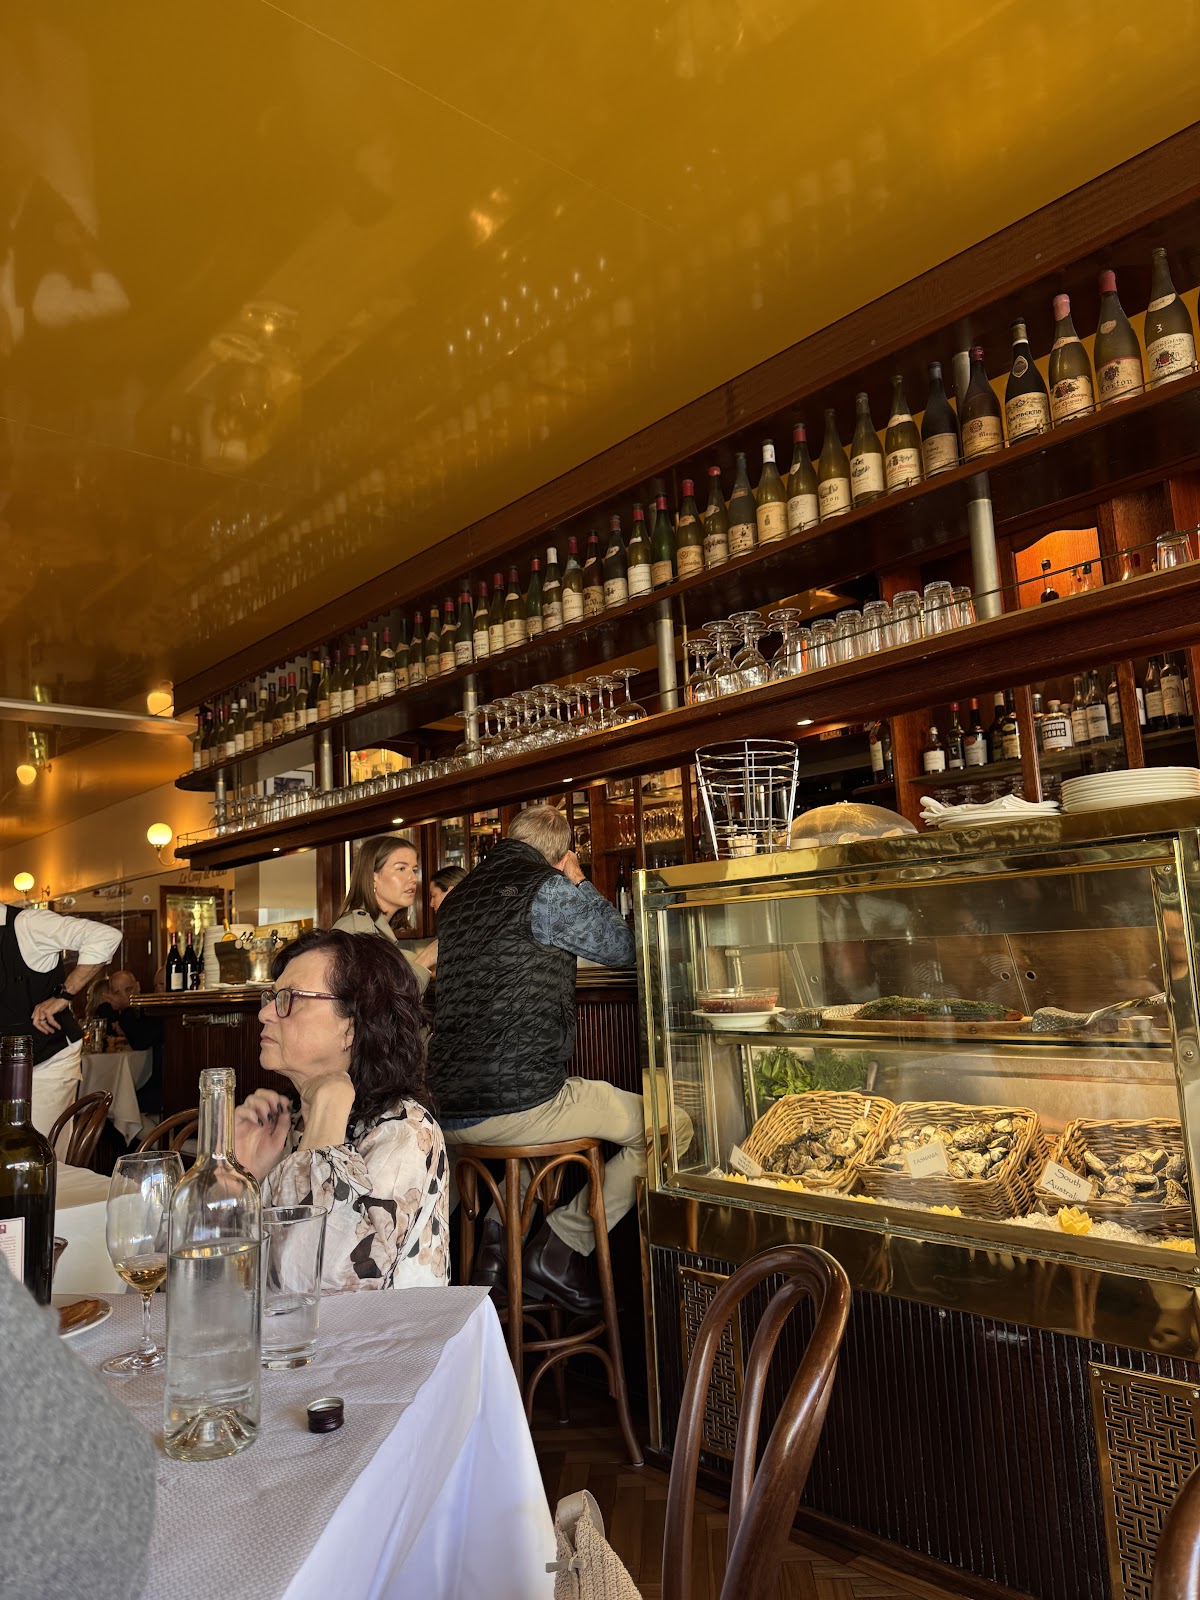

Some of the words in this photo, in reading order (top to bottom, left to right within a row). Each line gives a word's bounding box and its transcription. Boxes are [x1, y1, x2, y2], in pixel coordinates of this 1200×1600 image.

[1155, 323, 1163, 333] 3
[913, 1151, 939, 1165] TASMANIA
[1054, 1169, 1081, 1188] South
